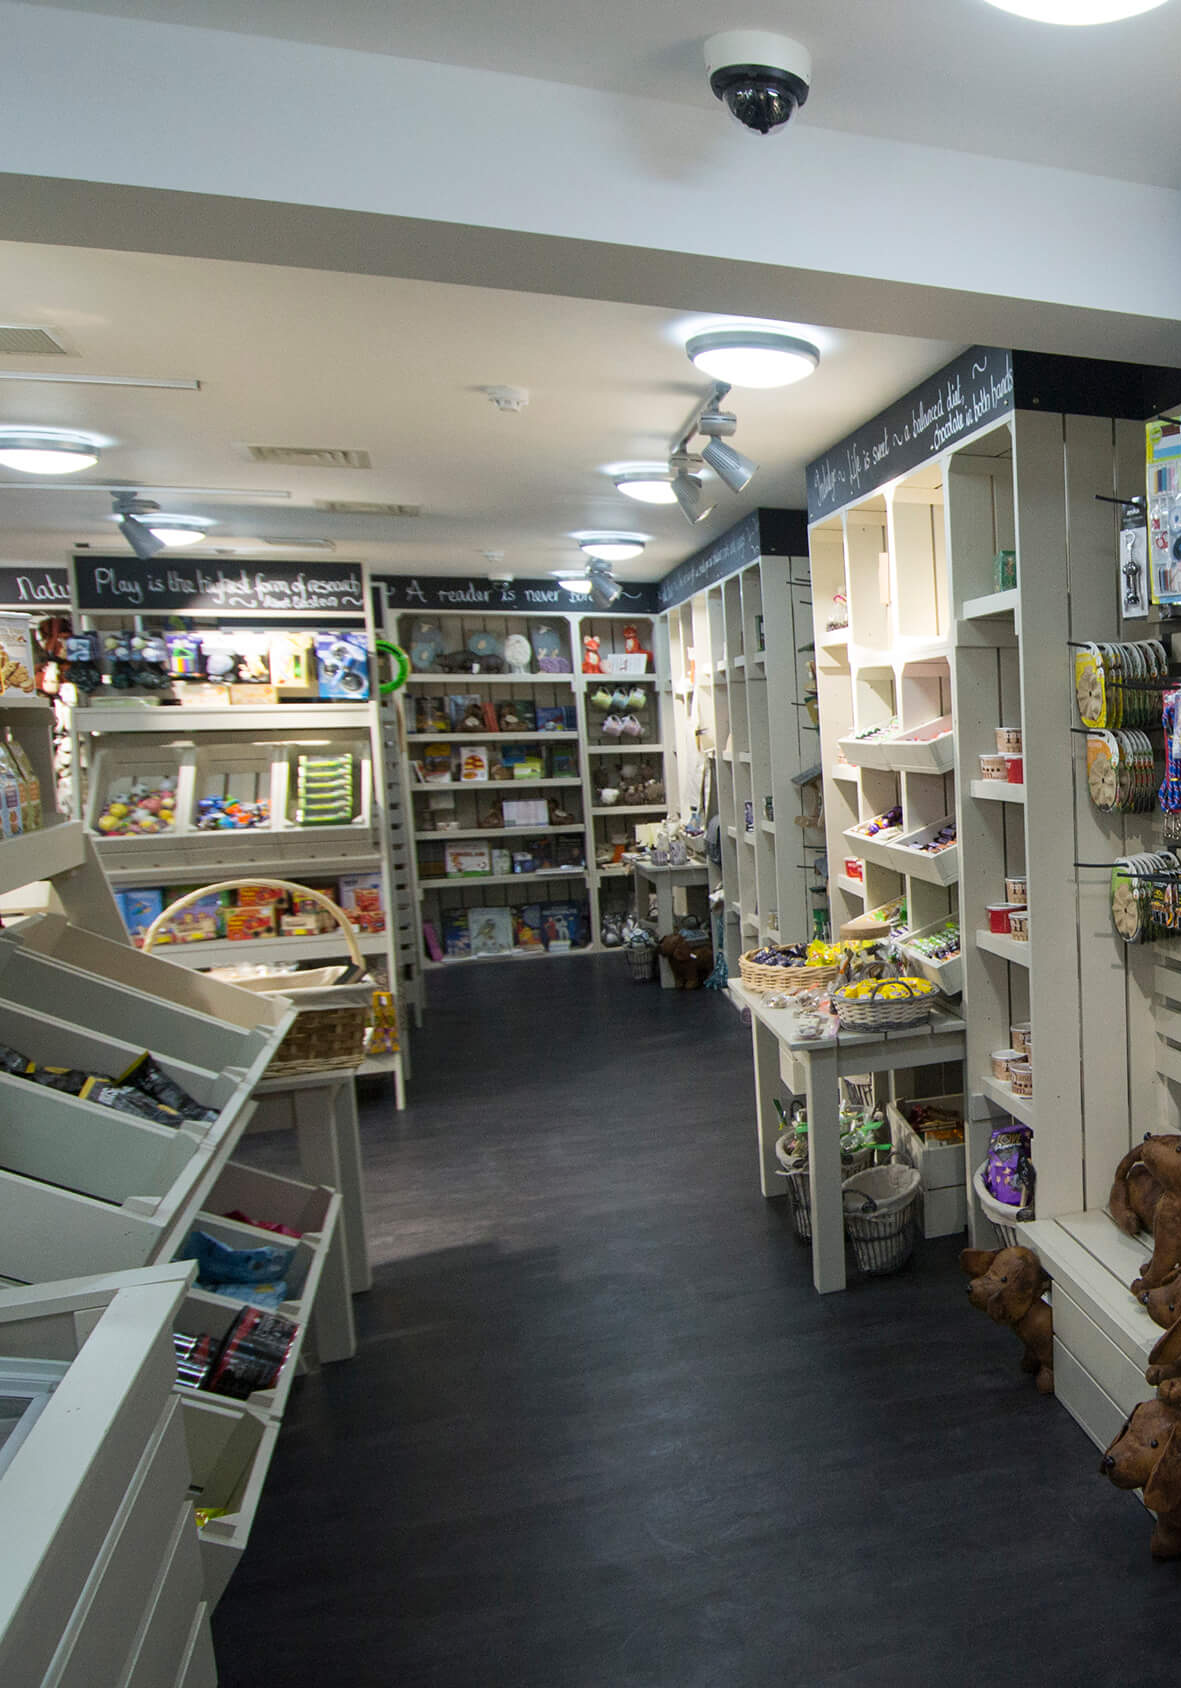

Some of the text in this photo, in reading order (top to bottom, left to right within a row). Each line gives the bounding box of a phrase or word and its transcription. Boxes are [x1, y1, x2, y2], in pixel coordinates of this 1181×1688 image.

[94, 567, 142, 604] Play
[147, 574, 165, 594] is
[167, 568, 193, 595] the
[405, 579, 428, 603] A
[439, 581, 491, 603] reader
[501, 587, 516, 601] is
[524, 588, 562, 603] never
